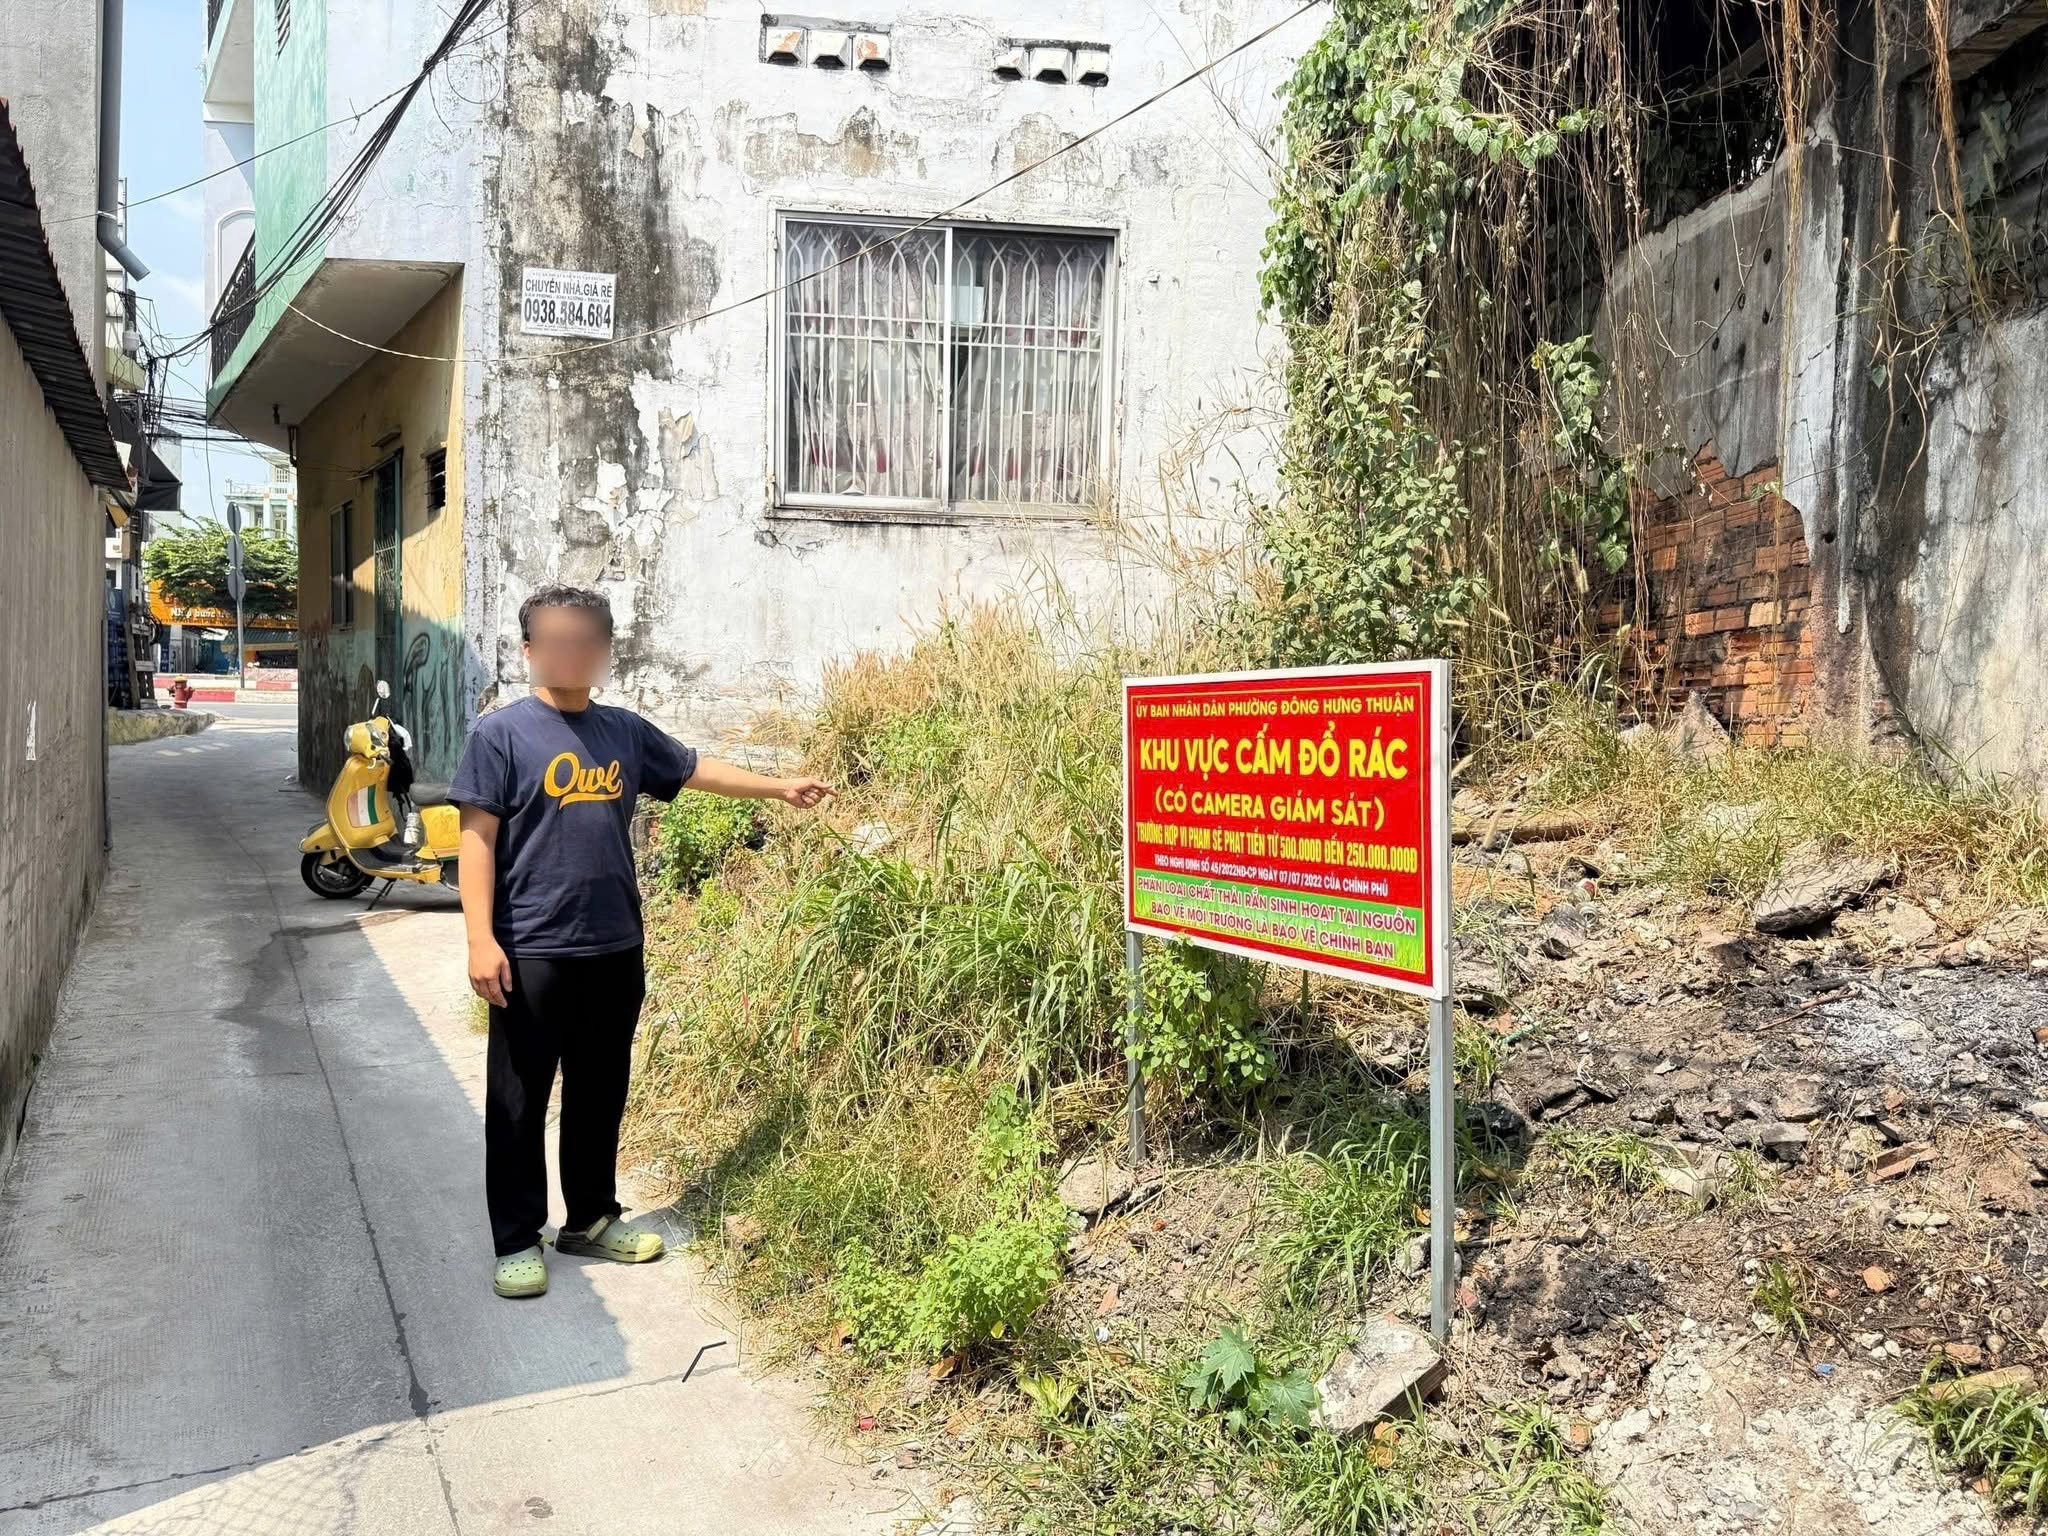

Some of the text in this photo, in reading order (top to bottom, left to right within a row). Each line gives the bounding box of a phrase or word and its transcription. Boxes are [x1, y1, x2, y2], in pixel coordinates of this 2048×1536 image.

[1150, 704, 1169, 717] BAN
[1172, 700, 1200, 717] NHÂN
[1203, 698, 1225, 716] DÂN
[1228, 697, 1277, 716] PHƯỜNG
[1281, 695, 1319, 715] ĐÔNG
[1323, 696, 1362, 714] HƯNG
[1365, 691, 1414, 717] THUẬN
[1140, 720, 1408, 781] KHU VỰC CẤM ĐỔ RÁC
[544, 752, 623, 810] Owl
[1155, 784, 1385, 831] (CÓ CAMERA GIÁM SÁT)
[1136, 818, 1163, 844] TRƯỜNG
[1164, 823, 1179, 851] HỢP
[1179, 826, 1188, 847] VI
[1188, 827, 1211, 854] PHẠM
[1224, 831, 1245, 858] PHẠT
[1324, 833, 1344, 865] ĐẾN
[1346, 842, 1418, 873] 250.000.000Đ
[1154, 853, 1169, 867] THEO
[1201, 856, 1209, 873] SỐ
[1258, 864, 1279, 883] NGÀY
[1323, 872, 1341, 890] CỦA
[1342, 876, 1369, 894] CHÍNH
[1137, 876, 1162, 893] PHÂN
[1188, 881, 1215, 901] CHẤT
[1218, 886, 1242, 906] THẢI
[1245, 888, 1267, 910] RẮN
[1270, 897, 1298, 915] SINH
[1301, 902, 1336, 925] HOẠT
[1338, 907, 1359, 929] TẠI
[1362, 908, 1416, 935] NGUỒN
[1187, 904, 1206, 923] MÔI
[1209, 911, 1253, 932] TRƯỜNG
[1256, 917, 1269, 935] LÀ
[1272, 919, 1297, 940] BẢO
[1301, 926, 1316, 948] VỆ
[1319, 929, 1361, 953] CHÍNH
[1365, 939, 1394, 961] BẠN
